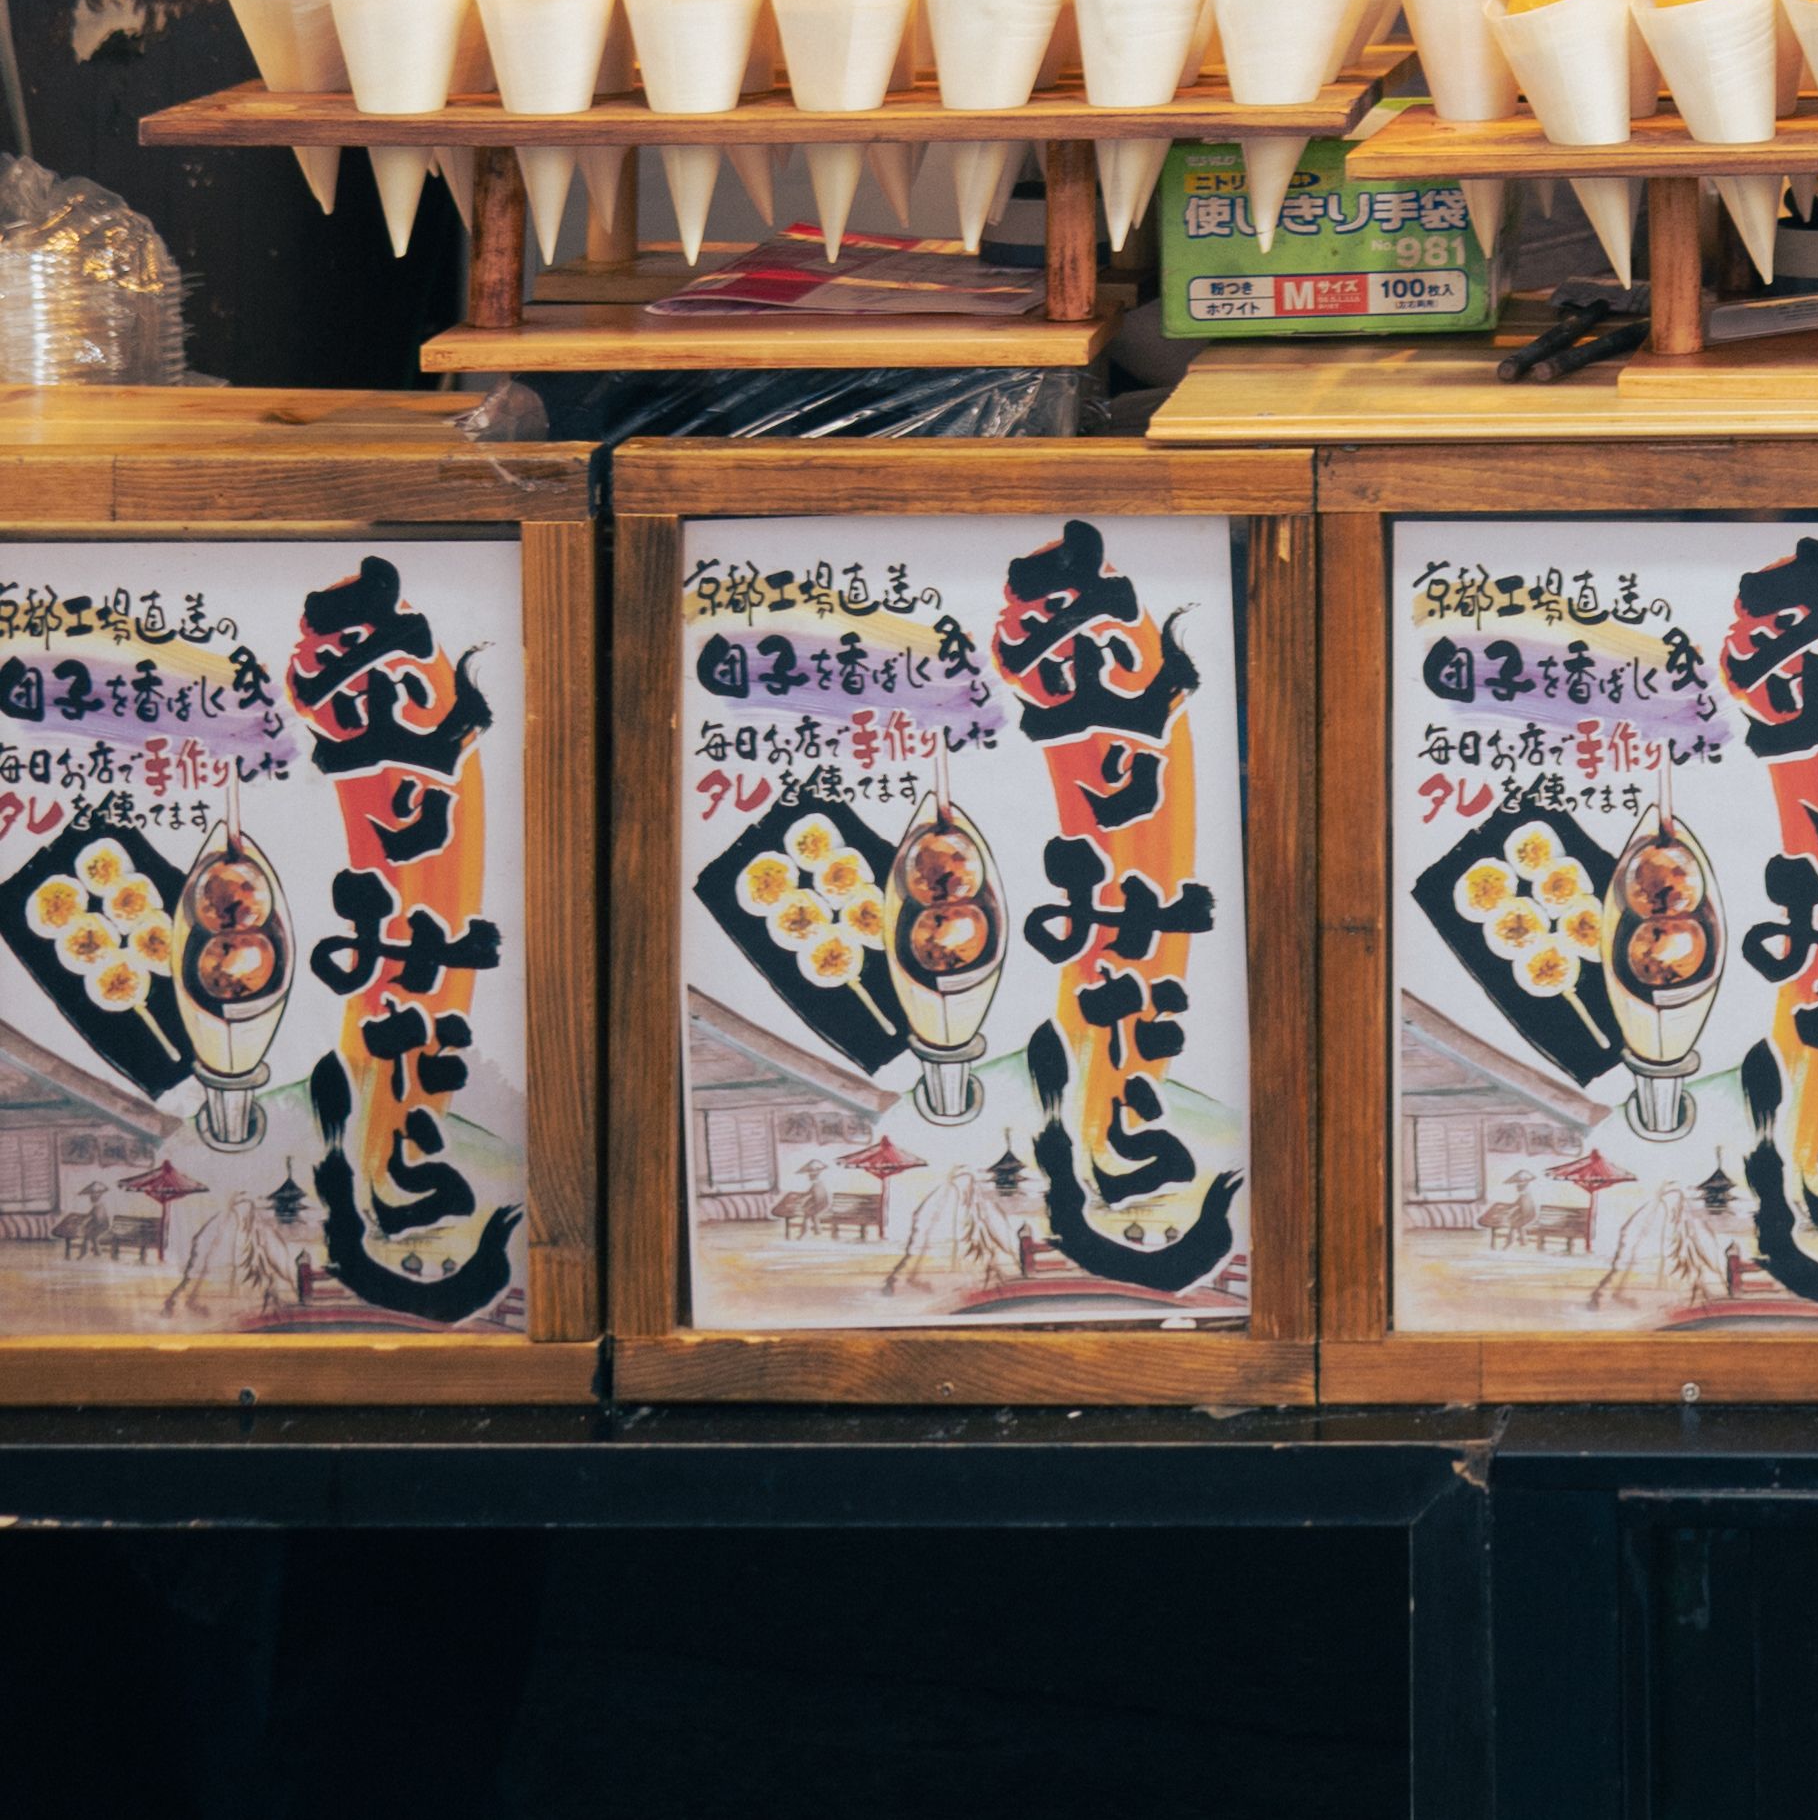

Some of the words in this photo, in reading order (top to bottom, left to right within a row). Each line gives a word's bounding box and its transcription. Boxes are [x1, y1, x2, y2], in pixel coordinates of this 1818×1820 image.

[1194, 174, 1248, 193] ニトリ
[1396, 236, 1466, 268] 981
[1209, 281, 1254, 297] 粉つき
[1204, 301, 1262, 316] ホワイト
